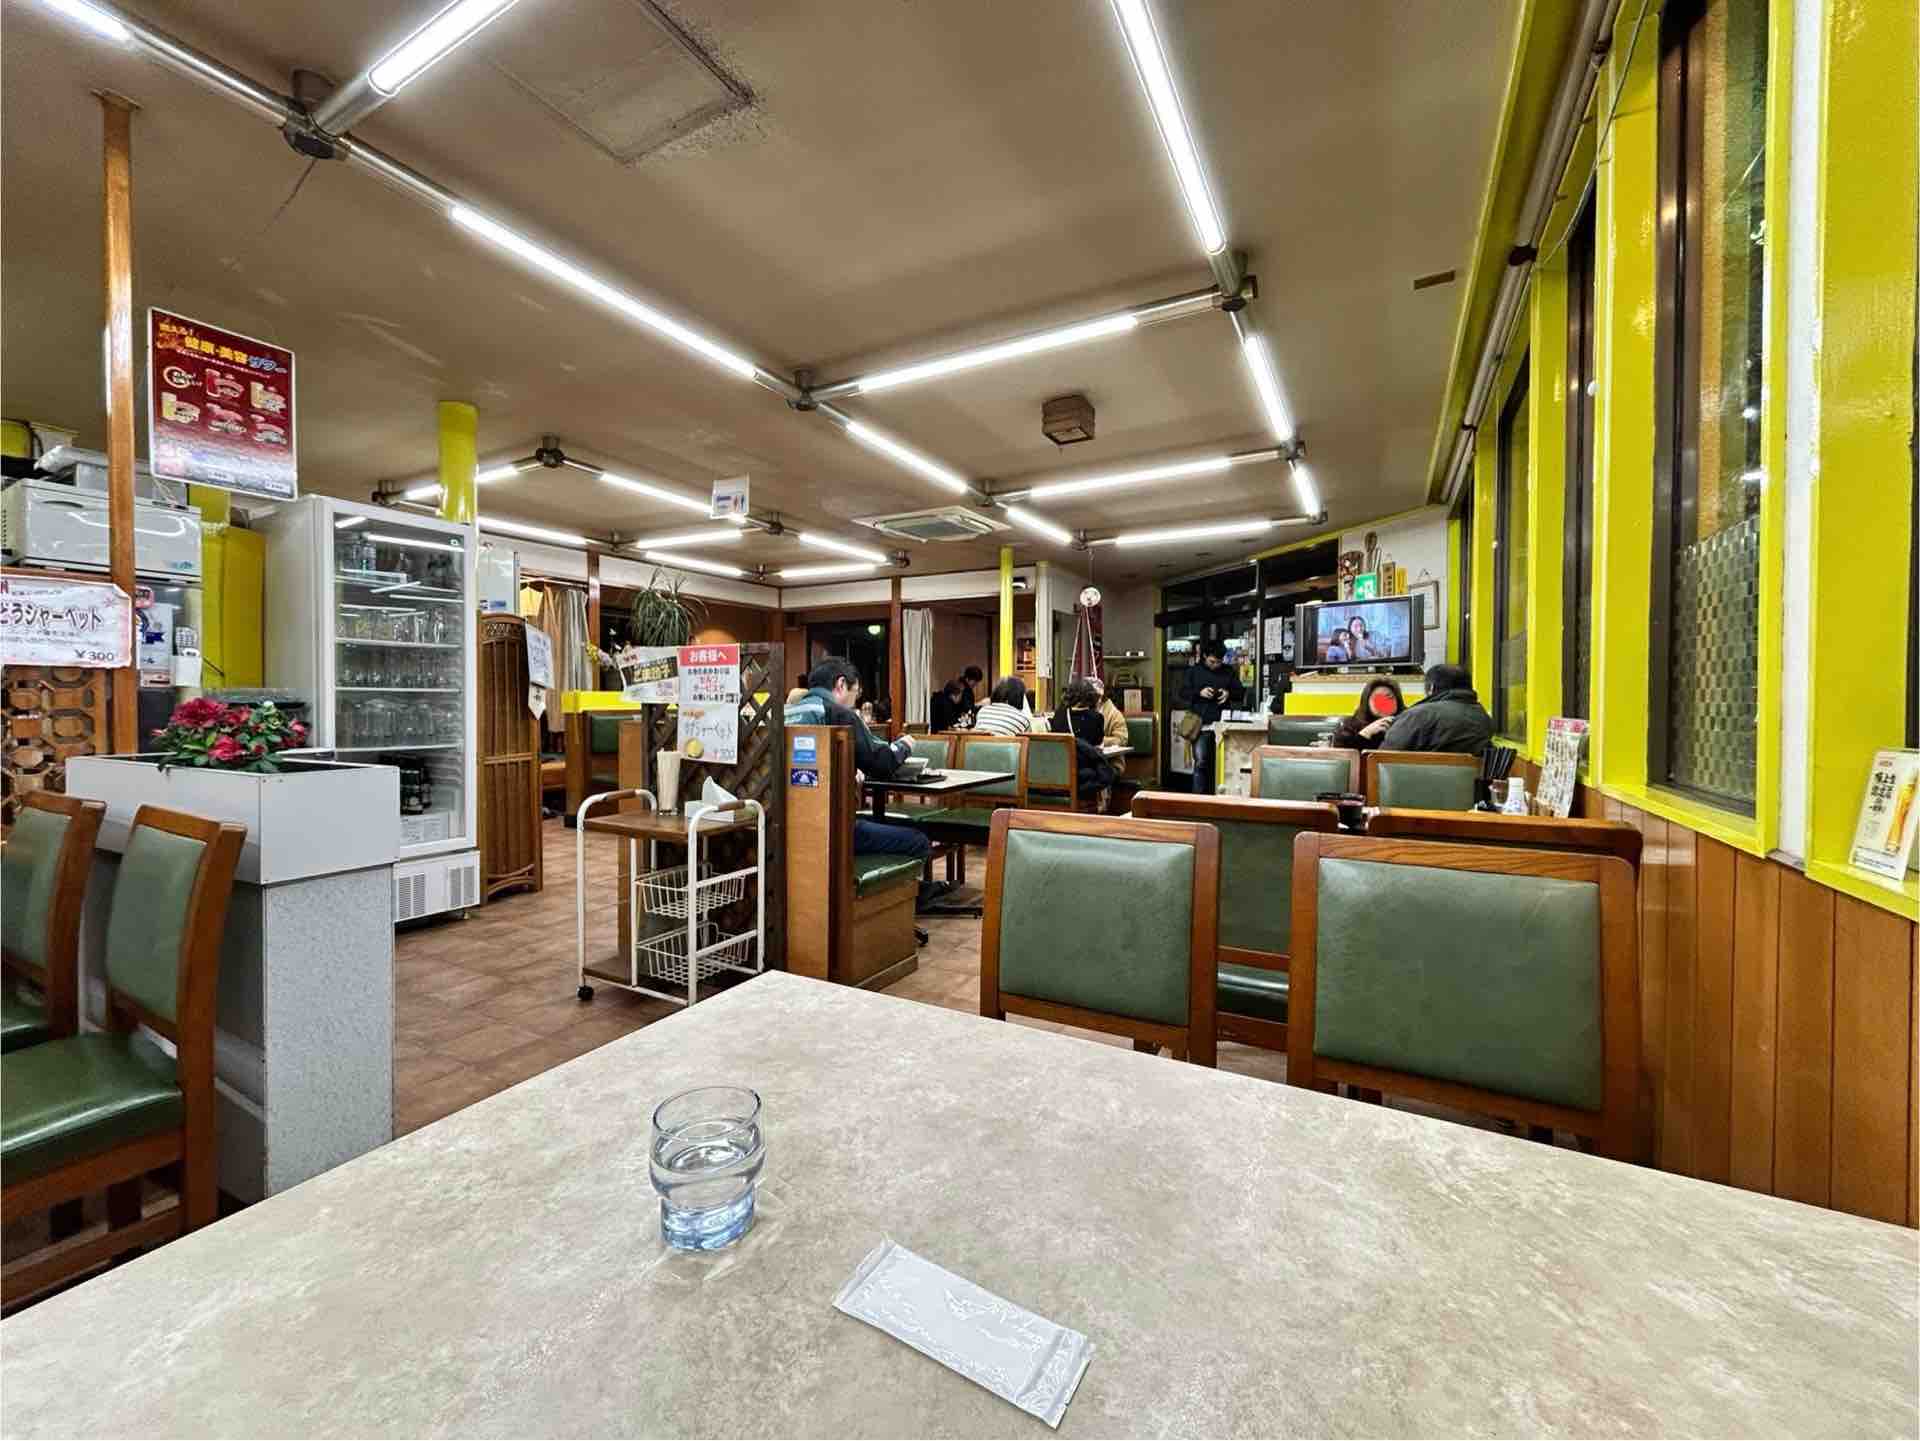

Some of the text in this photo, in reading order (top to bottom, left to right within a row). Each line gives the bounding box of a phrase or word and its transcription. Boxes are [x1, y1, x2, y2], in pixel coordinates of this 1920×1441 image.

[75, 650, 115, 662] ¥300
[690, 649, 729, 663] お客様へ
